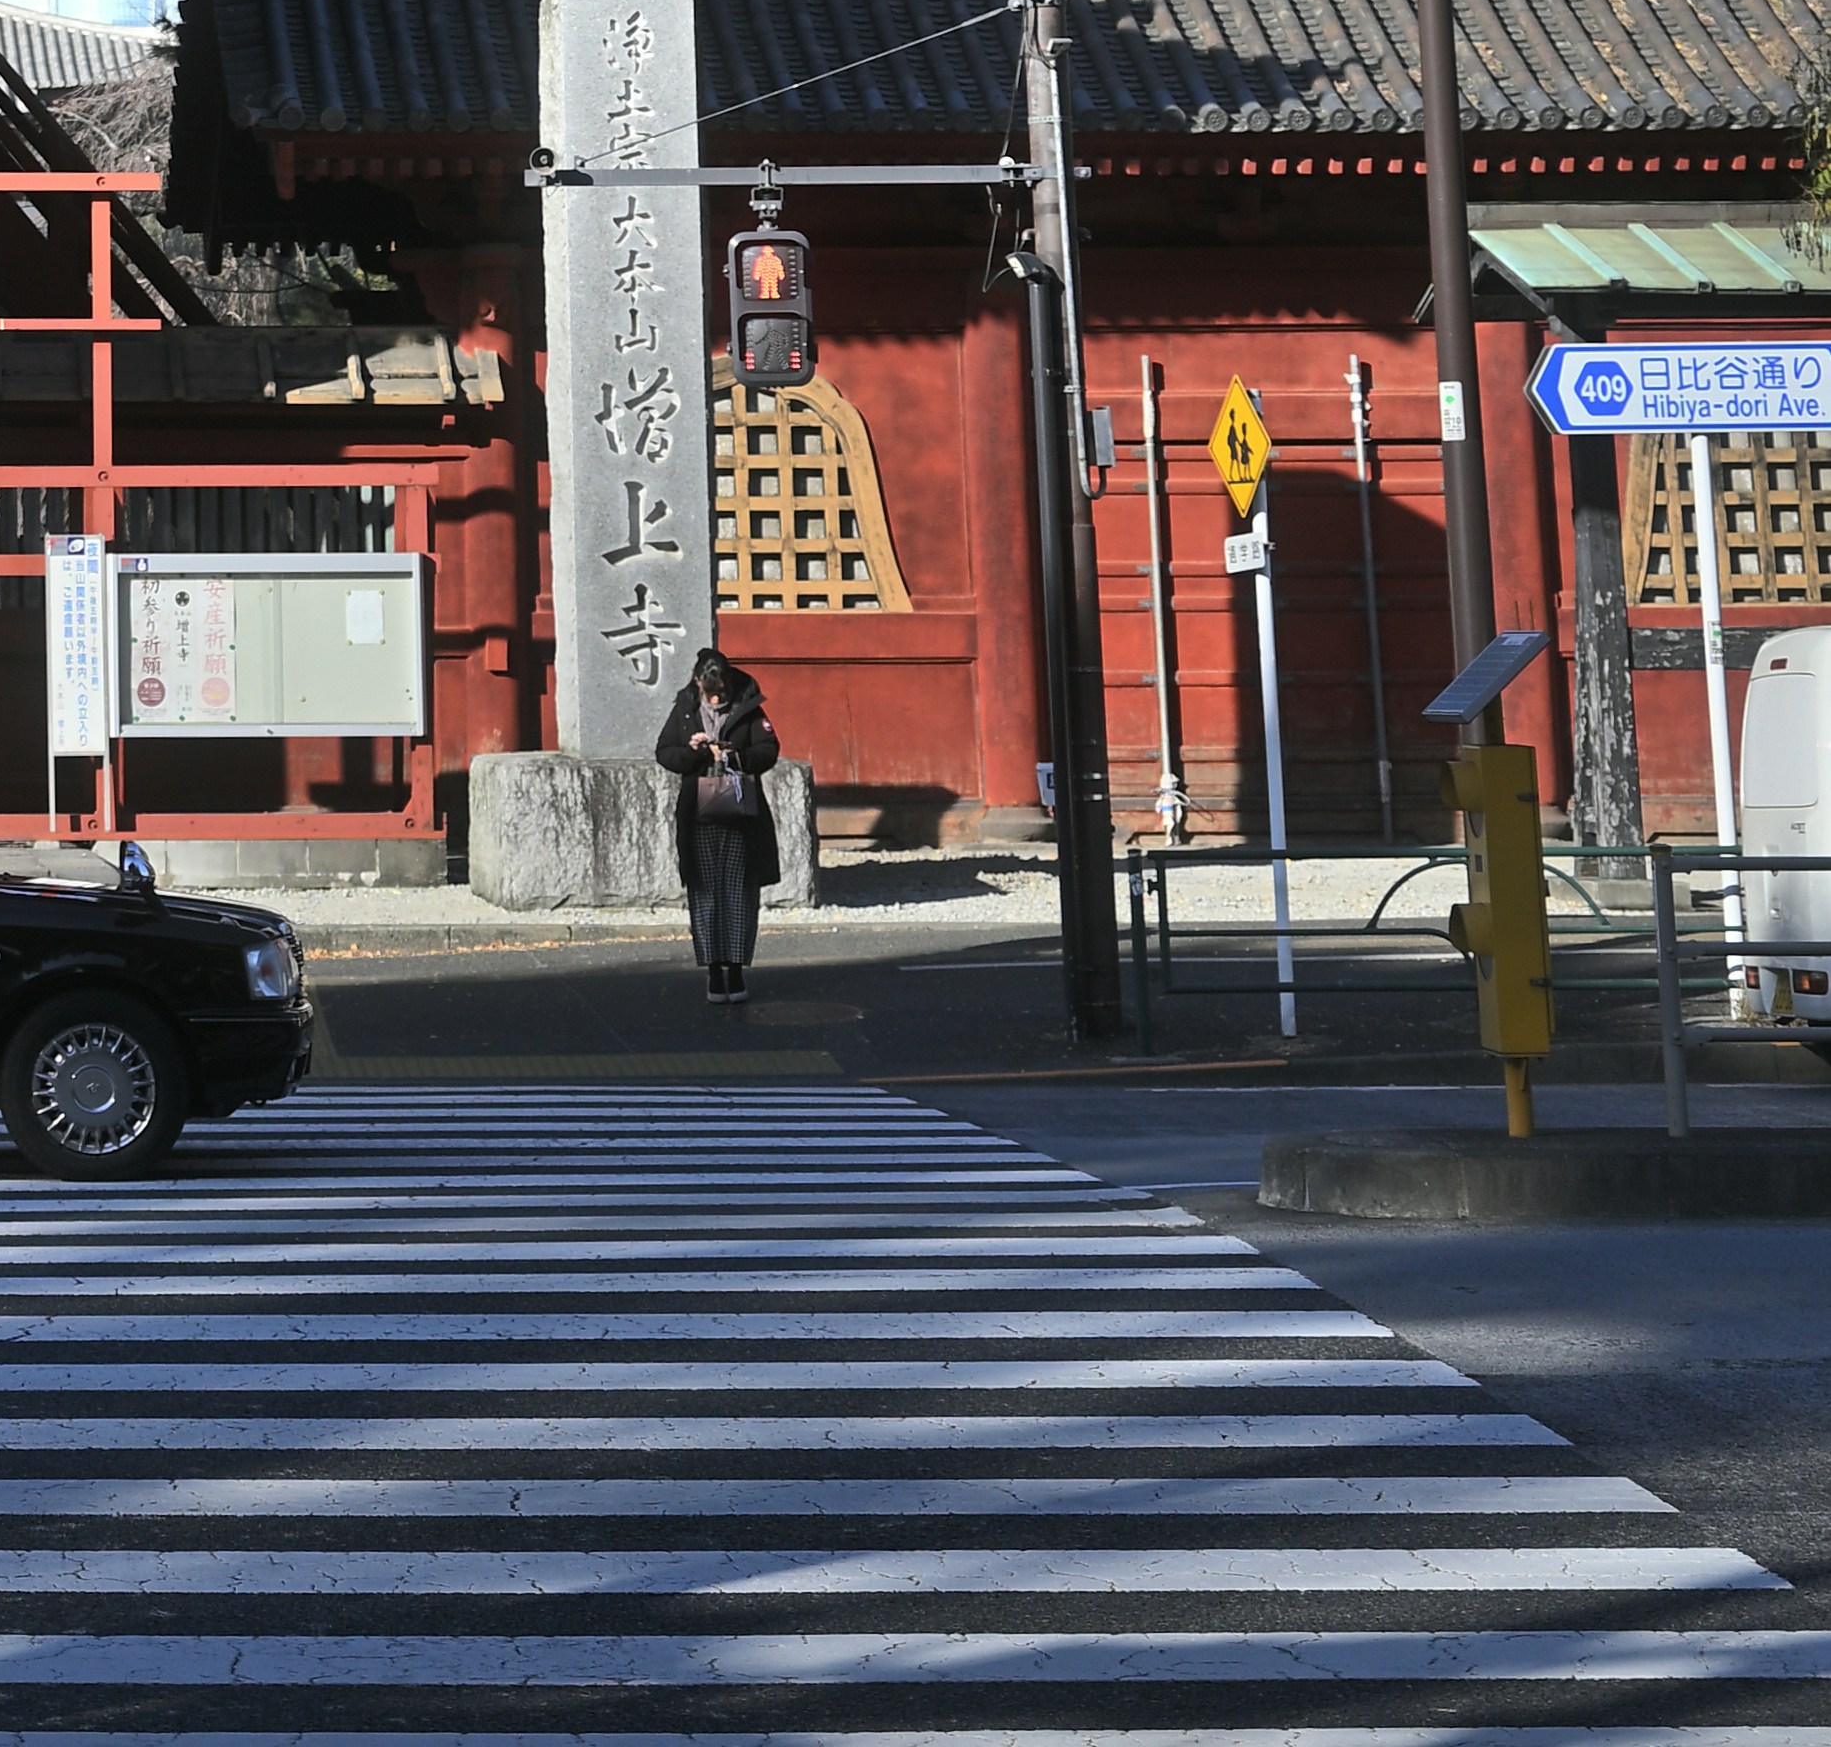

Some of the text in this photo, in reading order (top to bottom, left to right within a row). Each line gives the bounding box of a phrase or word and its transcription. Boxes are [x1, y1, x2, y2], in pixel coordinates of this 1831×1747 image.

[1581, 375, 1627, 403] 409
[1640, 356, 1822, 391] 日比谷通り
[1643, 394, 1825, 422] Hibiya-dori Ave.
[176, 619, 190, 662] 増上寺
[203, 577, 227, 675] 安産祈願
